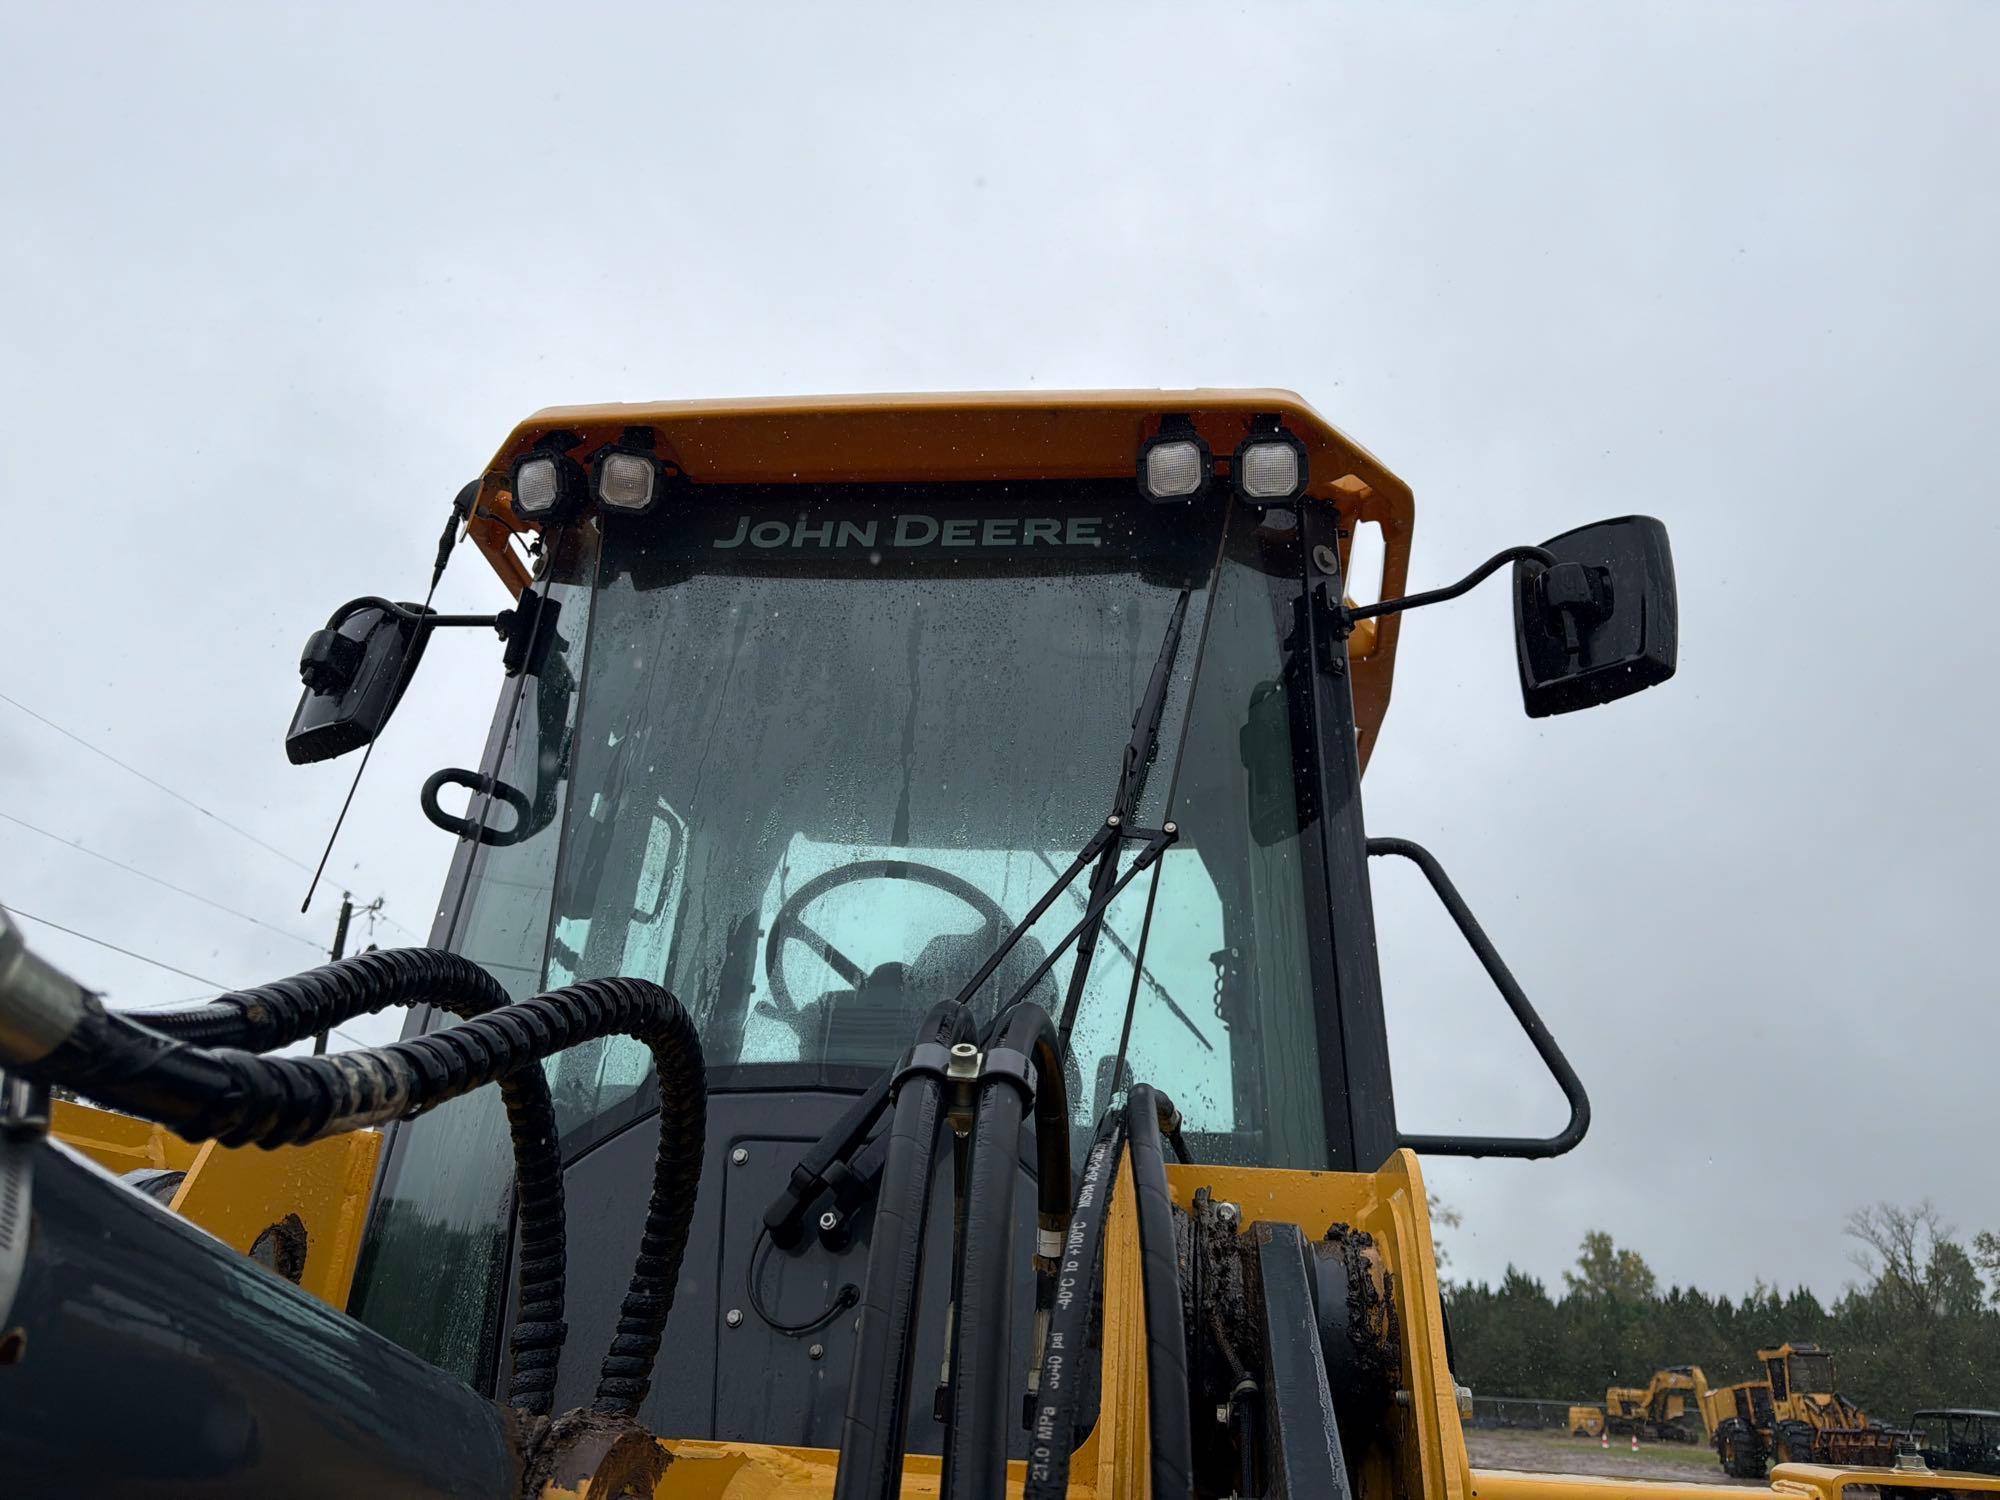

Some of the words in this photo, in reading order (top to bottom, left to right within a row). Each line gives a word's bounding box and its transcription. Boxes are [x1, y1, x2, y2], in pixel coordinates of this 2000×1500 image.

[713, 516, 878, 548] JOHN
[894, 514, 1102, 547] DEERE
[1078, 1184, 1096, 1208] MSHA
[1038, 1406, 1056, 1440] MPa
[1032, 1447, 1050, 1481] 21.0
